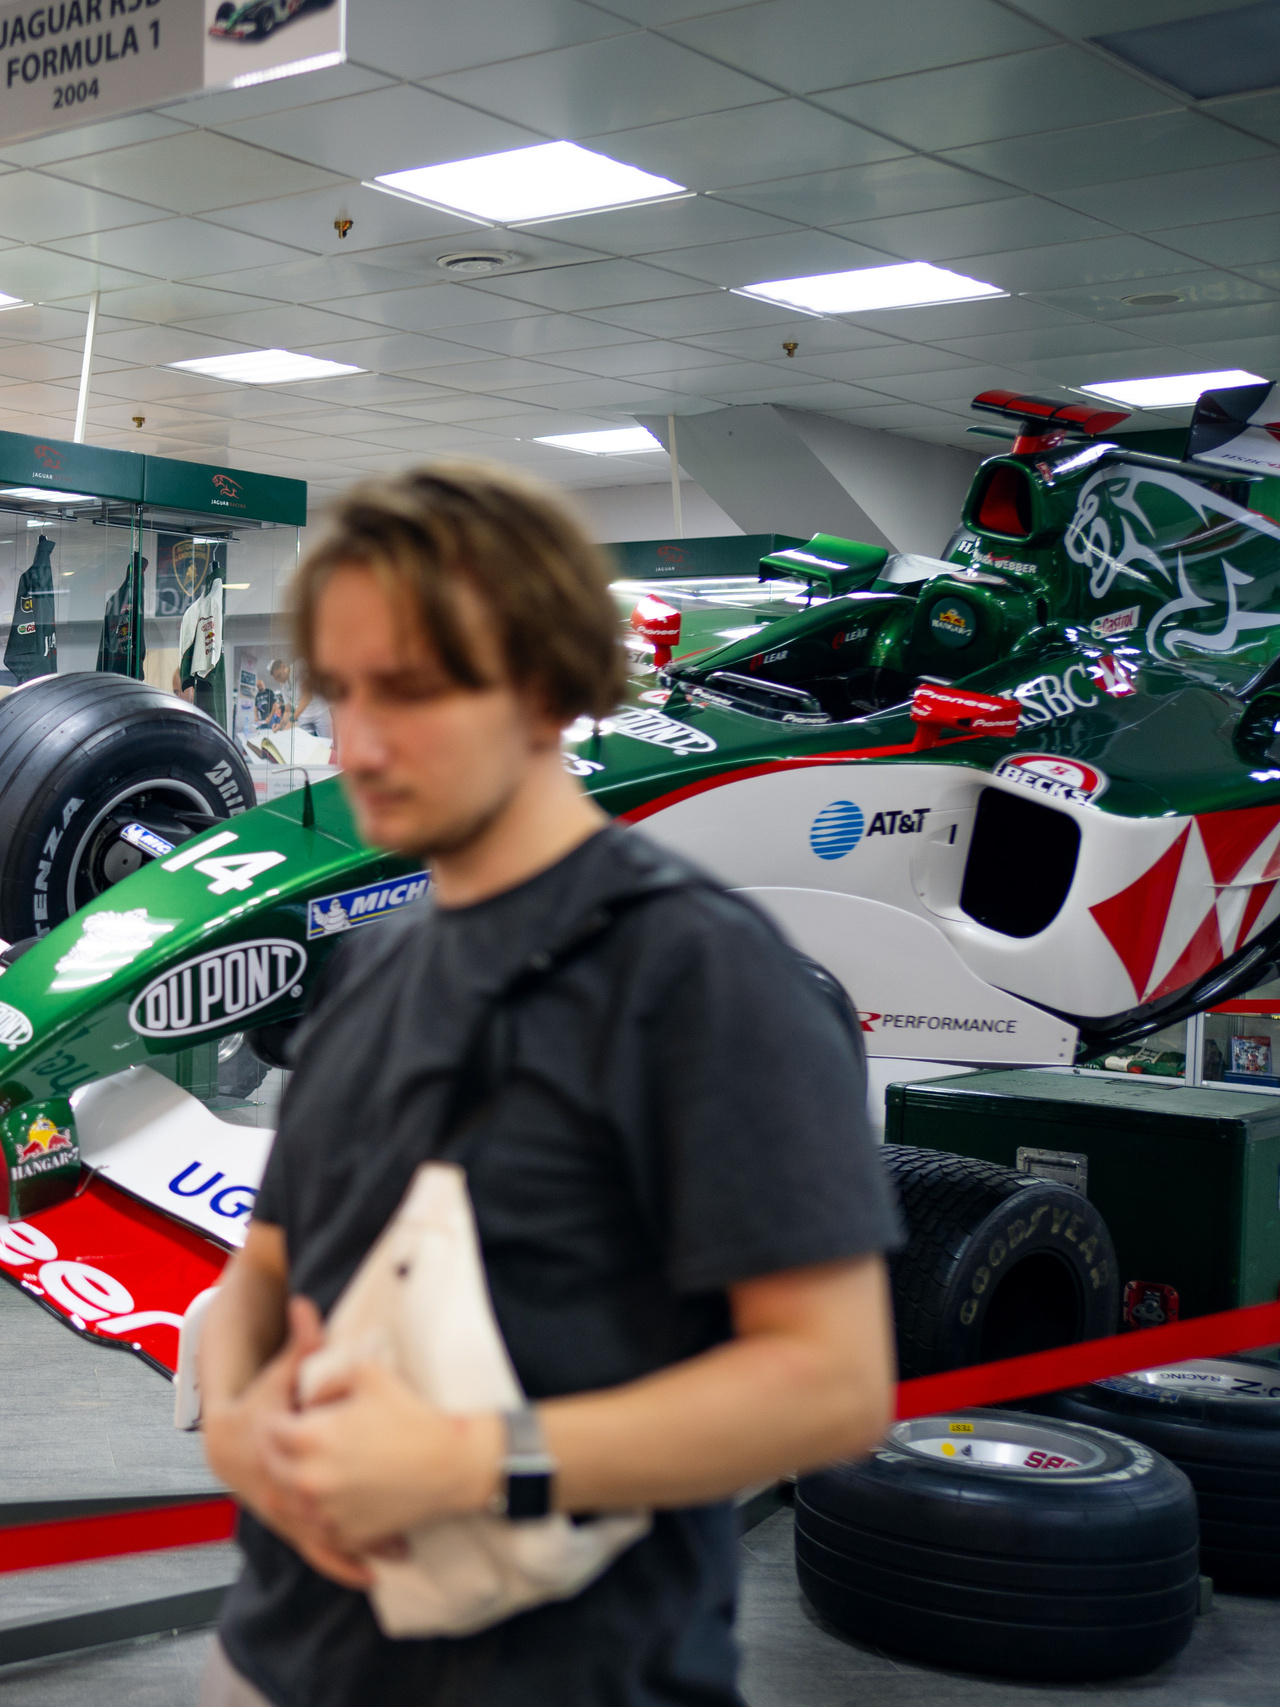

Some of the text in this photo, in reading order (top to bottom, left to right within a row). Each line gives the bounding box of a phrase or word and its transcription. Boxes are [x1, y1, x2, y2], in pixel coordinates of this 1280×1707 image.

[7, 19, 160, 88] FORMULA 1
[53, 78, 100, 110] 2004
[32, 471, 53, 480] JAGUAR
[211, 499, 229, 507] JAGUAR
[994, 559, 1038, 574] WEBBER
[637, 625, 680, 636] Pioneer
[1102, 610, 1135, 634] Castrol
[844, 628, 869, 643] LEAR
[763, 650, 789, 665] LEAR
[692, 687, 734, 705] Pioneer
[914, 689, 1003, 712] Pioneer
[998, 663, 1099, 729] SBC
[782, 713, 830, 724] Pioneer
[972, 717, 1018, 728] Pioneer
[865, 808, 932, 837] AT&T
[160, 830, 288, 896] 14
[146, 945, 293, 1031] DU PONT
[882, 1013, 1017, 1034] PERFORMANCE
[960, 1205, 1109, 1326] GOODYEAR
